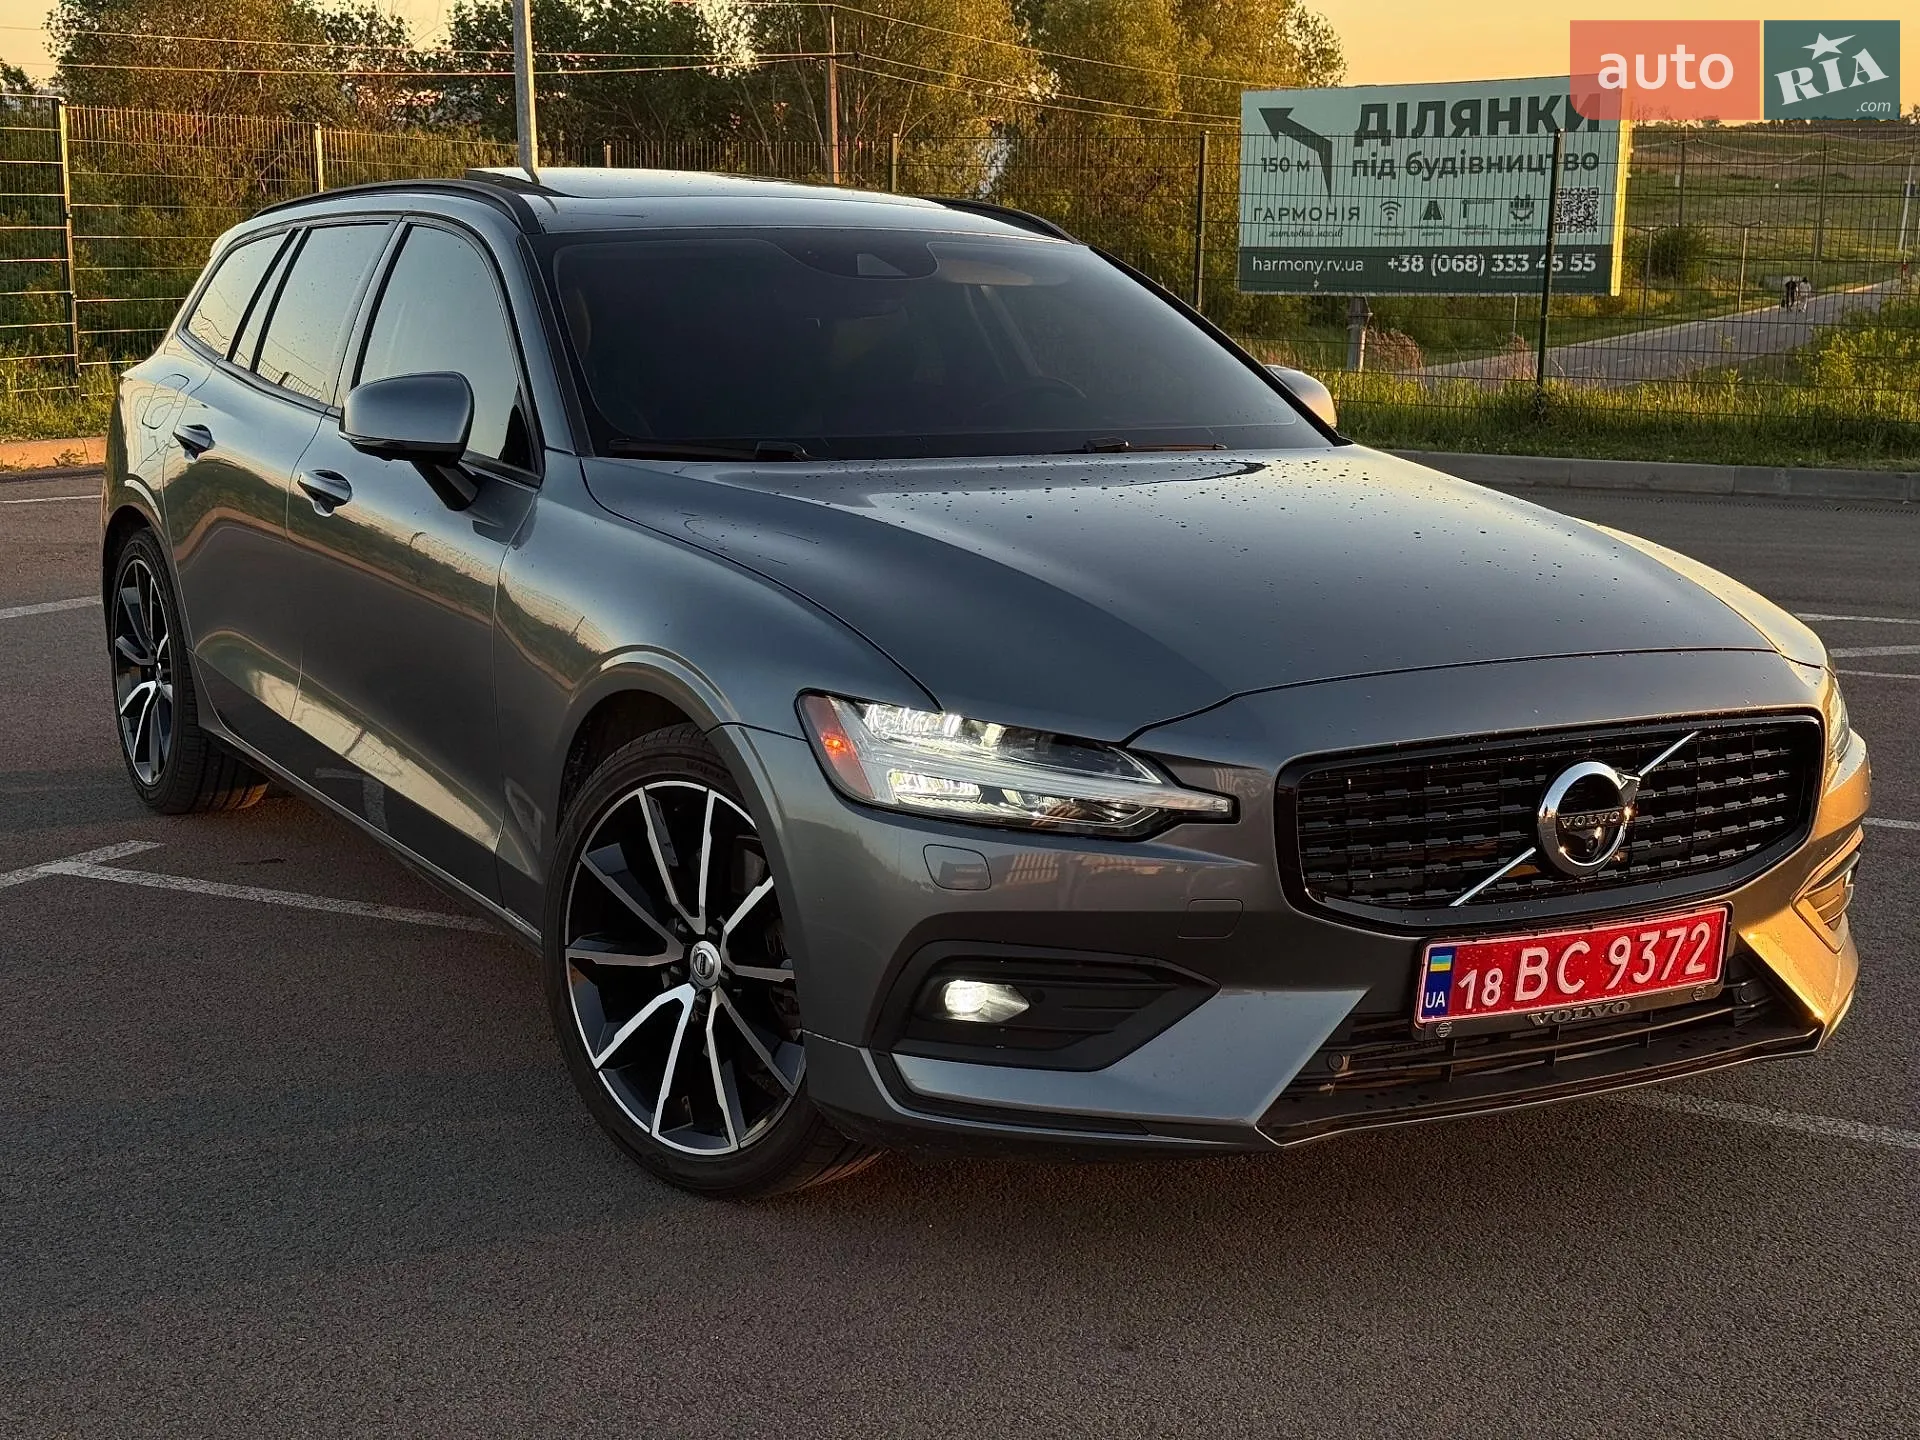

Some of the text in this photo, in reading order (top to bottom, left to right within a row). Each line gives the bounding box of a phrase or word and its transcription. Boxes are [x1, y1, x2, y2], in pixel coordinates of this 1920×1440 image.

[1354, 93, 1600, 148] ДІЛЯНКИ
[1261, 157, 1290, 173] 150
[1352, 149, 1600, 182] під будівницво
[1254, 207, 1361, 221] ГАРМОНІЯ
[1252, 256, 1364, 274] harmony.rv.ua
[1387, 253, 1425, 273] +38
[1430, 253, 1486, 277] (068)
[1491, 253, 1529, 272] 333
[1569, 253, 1597, 272] 55
[1559, 810, 1620, 829] VOLVO
[1458, 921, 1711, 1010] 18 BC 9372
[1425, 991, 1446, 1009] UA
[1527, 1000, 1631, 1026] VOLVO
